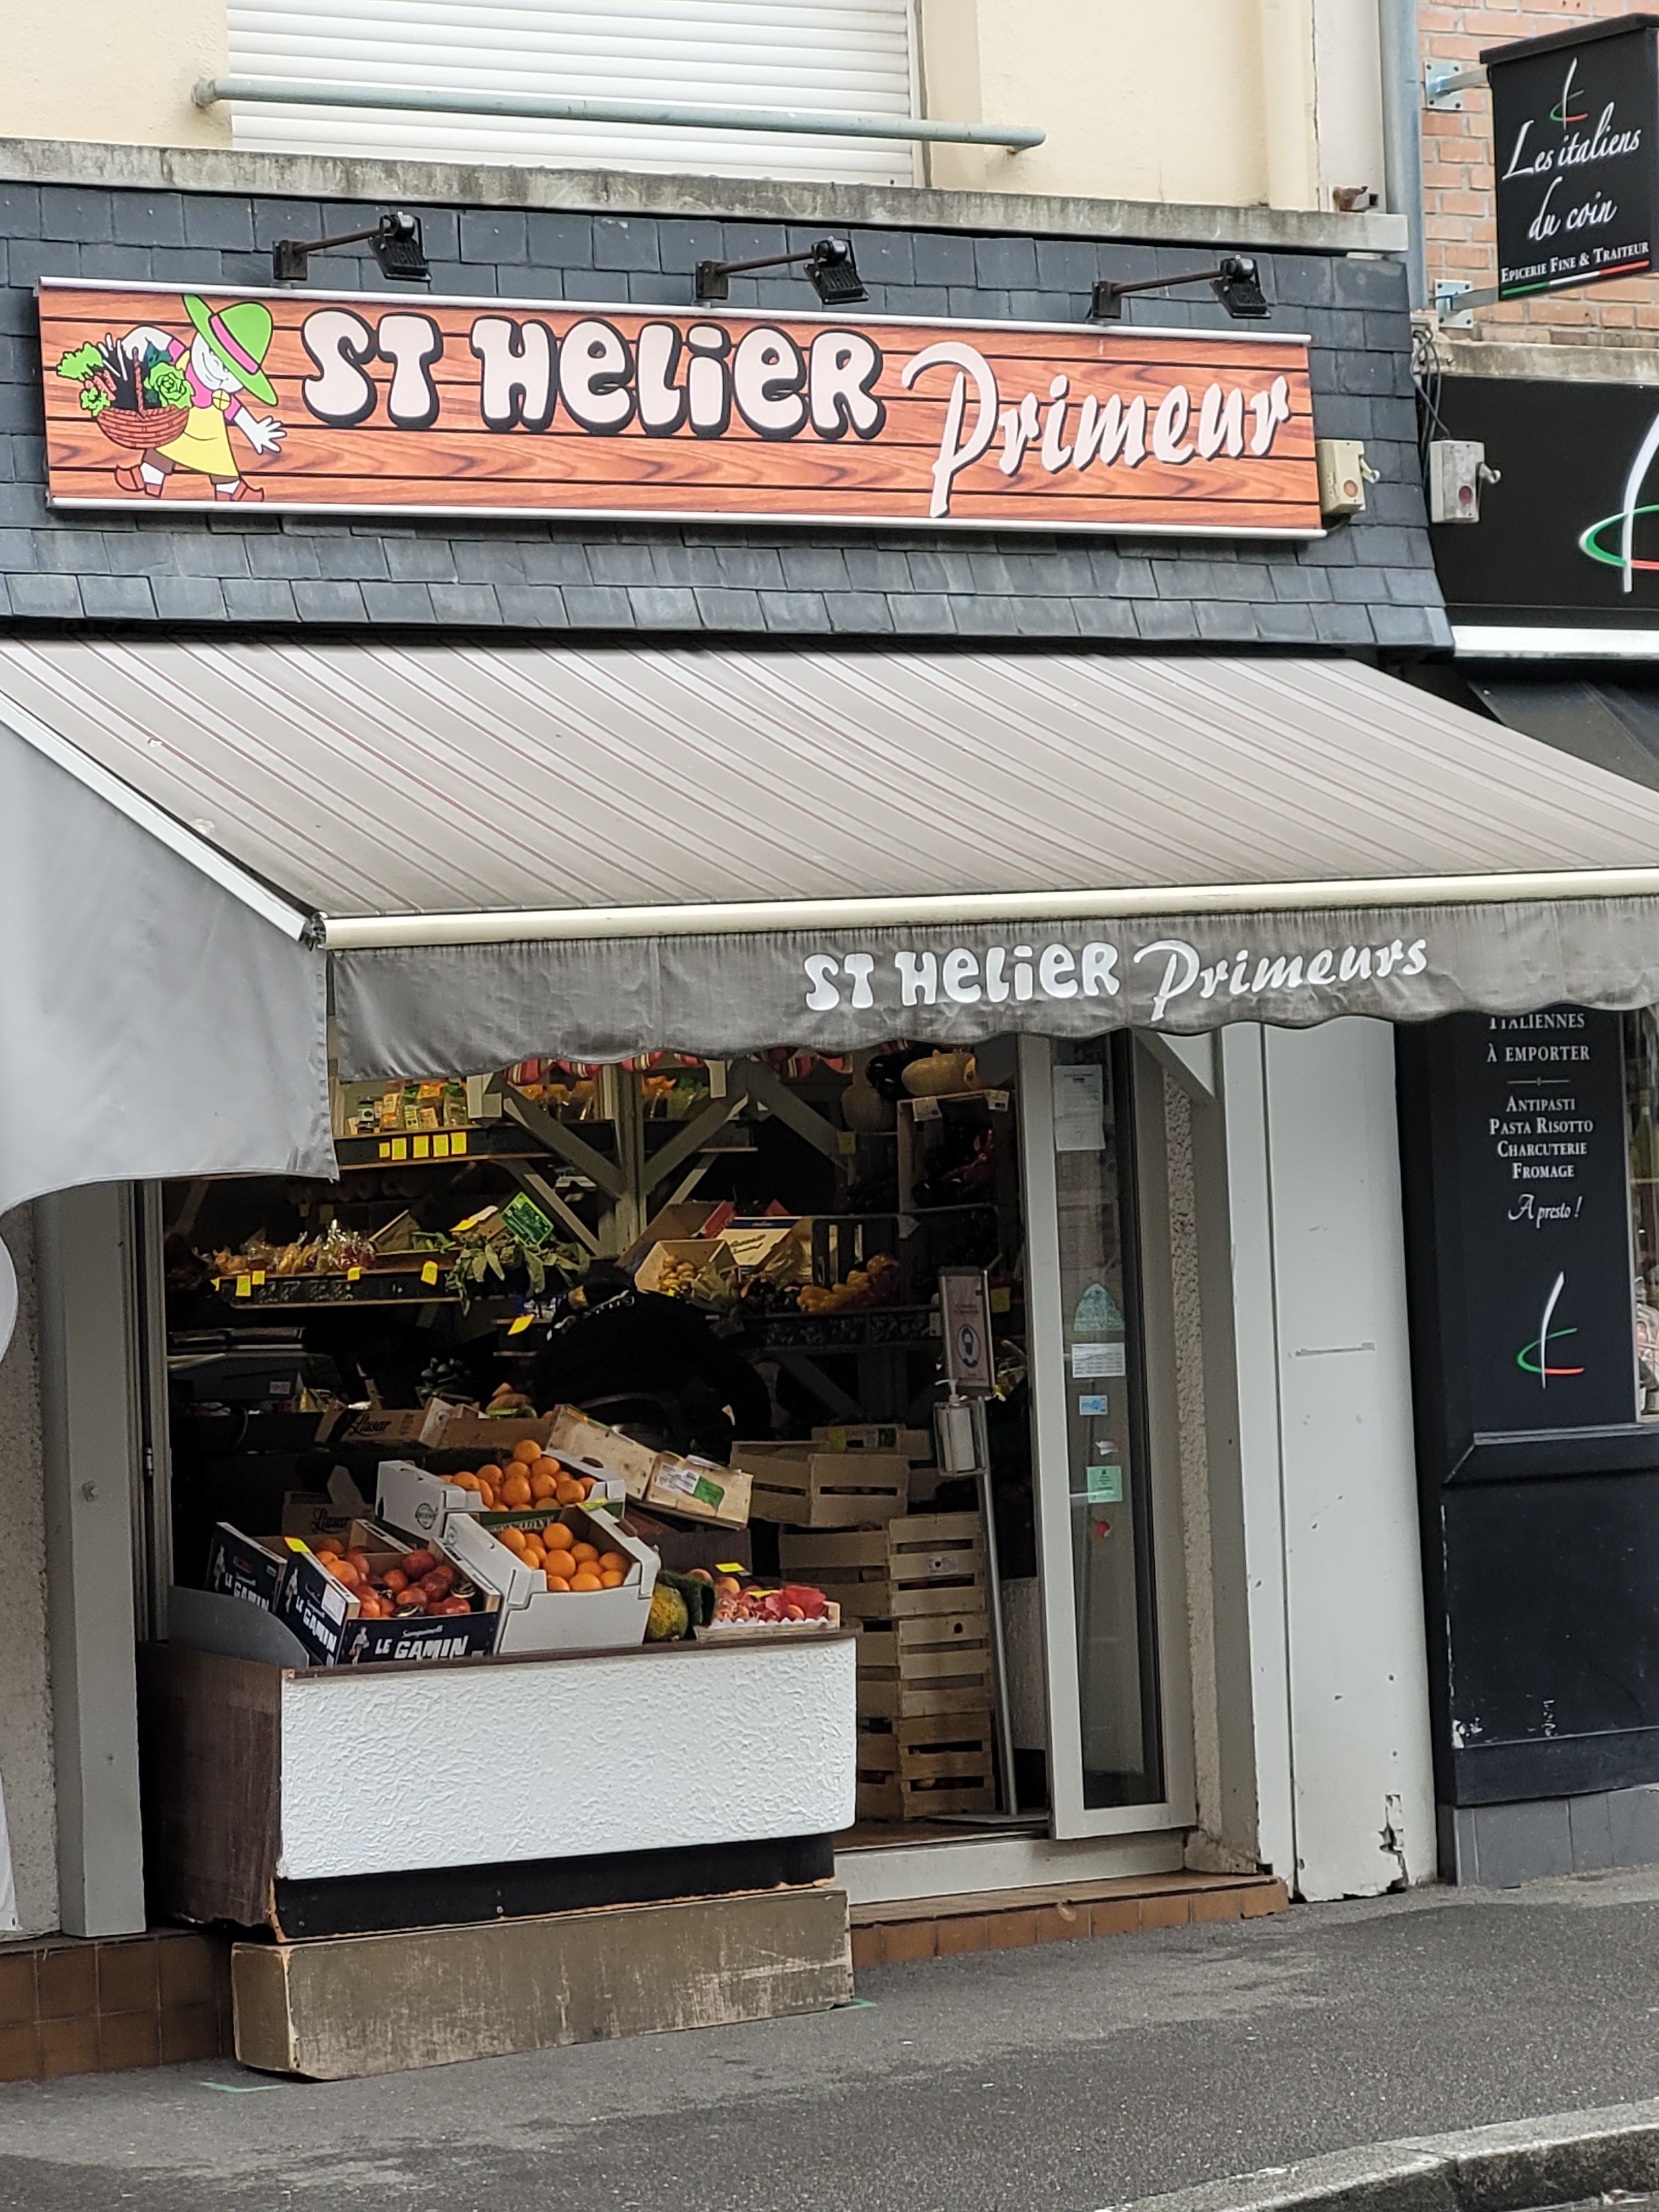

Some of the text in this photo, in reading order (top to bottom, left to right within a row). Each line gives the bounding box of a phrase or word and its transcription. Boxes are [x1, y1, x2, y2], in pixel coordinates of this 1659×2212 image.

[1502, 101, 1641, 180] Les italiens
[1528, 176, 1617, 241] du coin
[1579, 252, 1590, 267] &
[302, 307, 442, 430] ST
[901, 341, 1290, 518] Primeur
[803, 952, 875, 1011] ST
[1134, 939, 1427, 1021] Primeurs
[1487, 1043, 1590, 1063] À EMPORTER
[1489, 1117, 1594, 1135] PASTA RISOTTO
[1513, 1162, 1575, 1179] FROMAGE
[1537, 1203, 1571, 1228] presto
[302, 1607, 337, 1654] GAMIN
[375, 1634, 469, 1662] LE GAMIN
